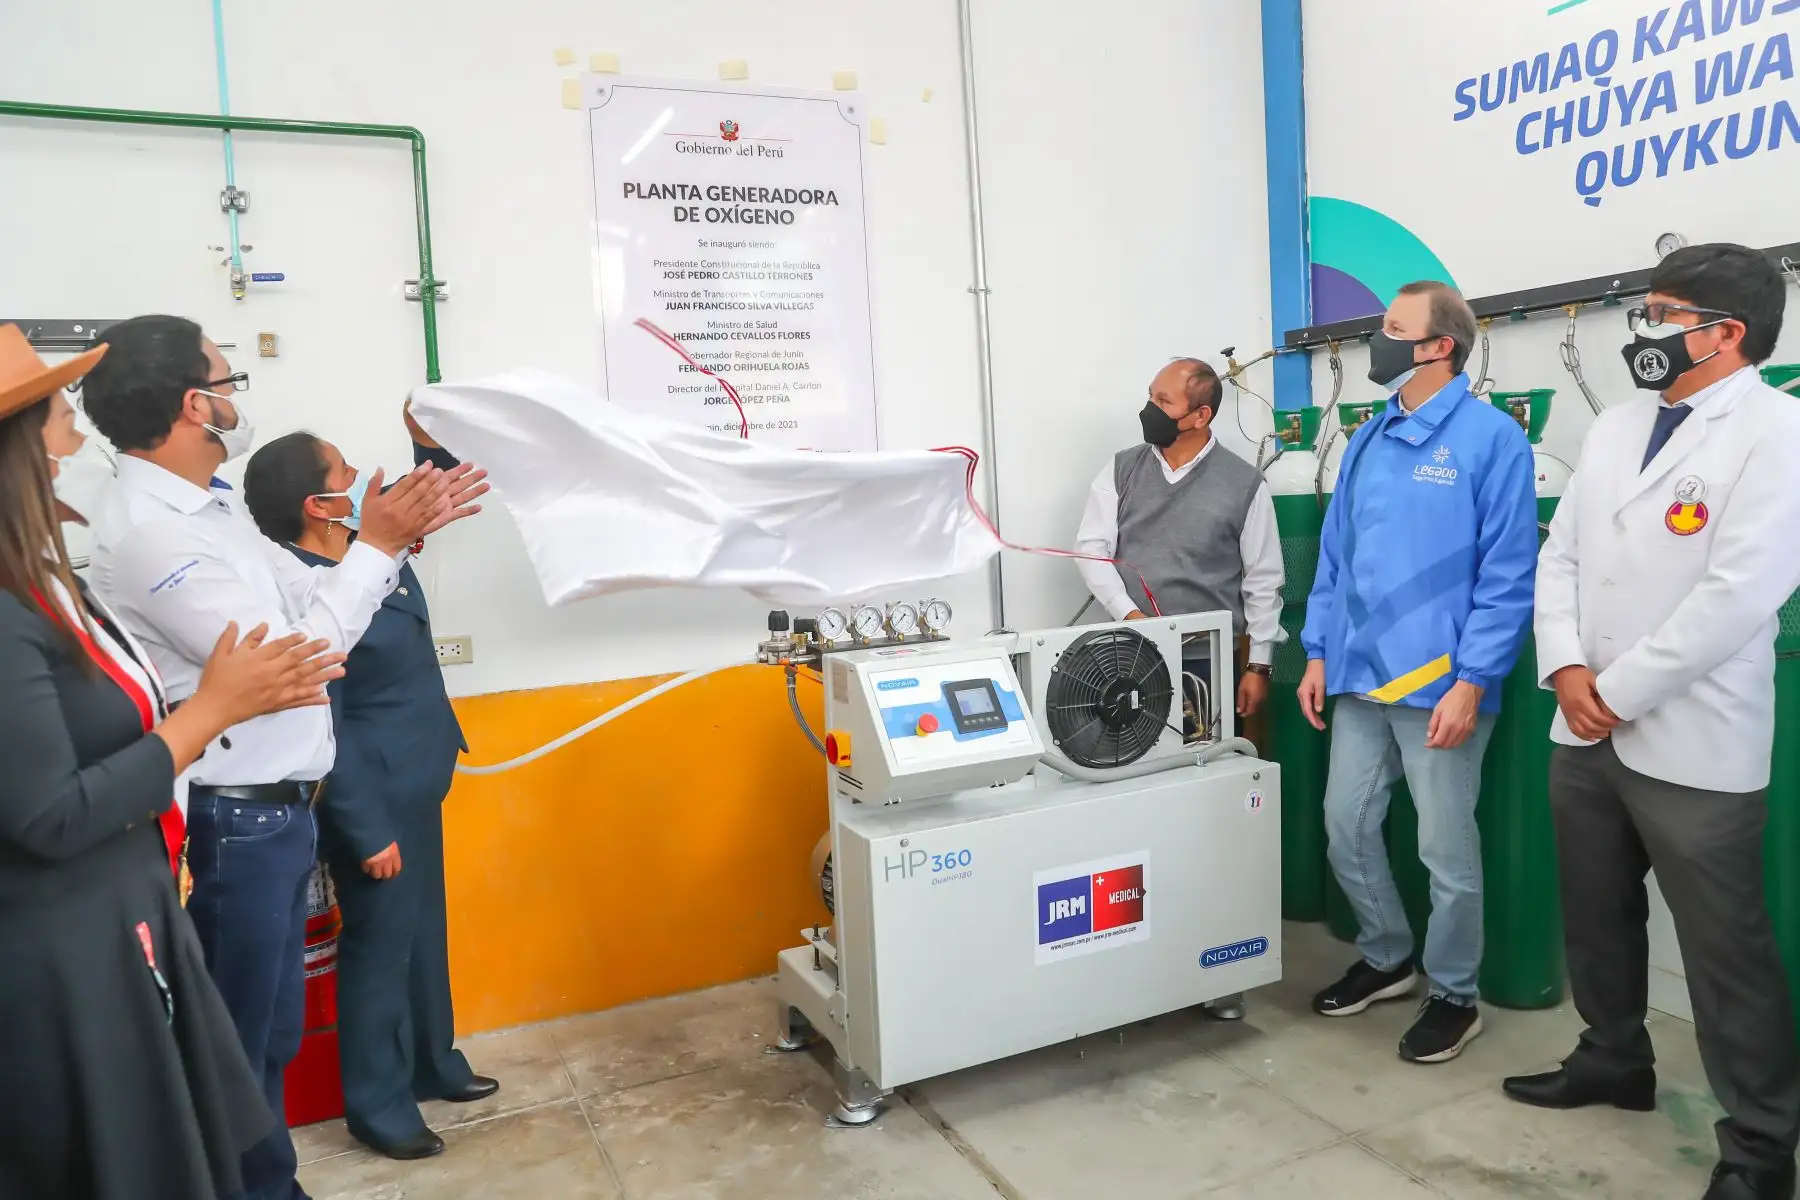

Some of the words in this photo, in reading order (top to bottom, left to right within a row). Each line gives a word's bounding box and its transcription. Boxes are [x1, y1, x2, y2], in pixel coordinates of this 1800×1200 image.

[1453, 29, 1618, 121] SUMAQ
[1632, 0, 1800, 63] KAW
[1515, 70, 1678, 155] CHUYA
[1695, 33, 1794, 105] WA
[675, 140, 733, 155] Gobierno
[736, 144, 754, 156] del
[758, 145, 784, 159] Perú
[623, 183, 703, 201] PLANTA
[706, 185, 839, 206] GENERADORA
[674, 206, 700, 223] DE
[704, 204, 795, 225] OXÍGENO
[698, 239, 708, 248] Se
[710, 239, 747, 250] inauguró
[653, 259, 698, 268] Presidente
[700, 260, 760, 269] Constitucional
[762, 261, 773, 269] de
[774, 261, 781, 269] la
[663, 269, 686, 280] JOSÉ
[688, 271, 720, 280] PEDRO
[722, 271, 765, 280] CASTILLO
[768, 272, 813, 281] TERRONES
[653, 290, 689, 298] Ministro
[691, 290, 702, 298] de
[704, 290, 751, 300] Transportes
[760, 291, 824, 299] Comunicaciones
[665, 302, 691, 311] JUAN
[693, 302, 745, 311] FRANCISCO
[747, 302, 772, 310] SILVA
[773, 302, 815, 311] VILLEGAS
[707, 321, 742, 329] Ministro
[743, 321, 754, 329] de
[755, 321, 778, 329] Salud
[674, 332, 729, 341] HERNANDO
[730, 331, 776, 341] CEVALLOS
[778, 331, 811, 340] FLORES
[686, 351, 733, 360] obernador
[734, 351, 769, 360] Regional
[771, 351, 782, 359] de
[733, 363, 780, 372] ORIHUELA
[781, 362, 810, 371] ROJAS
[668, 385, 702, 394] Director
[704, 385, 717, 393] del
[719, 384, 753, 393] Hspital
[755, 383, 781, 391] Daniel
[704, 396, 733, 405] JORGE
[737, 394, 764, 404] ÓPEZ
[766, 394, 791, 404] PEÑA
[766, 421, 776, 429] de
[778, 420, 798, 429] 2021
[884, 849, 928, 883] HP
[931, 849, 972, 872] 360
[1108, 888, 1140, 904] MEDICAL
[1044, 895, 1086, 925] JRM
[1206, 942, 1262, 963] NOVAIR
